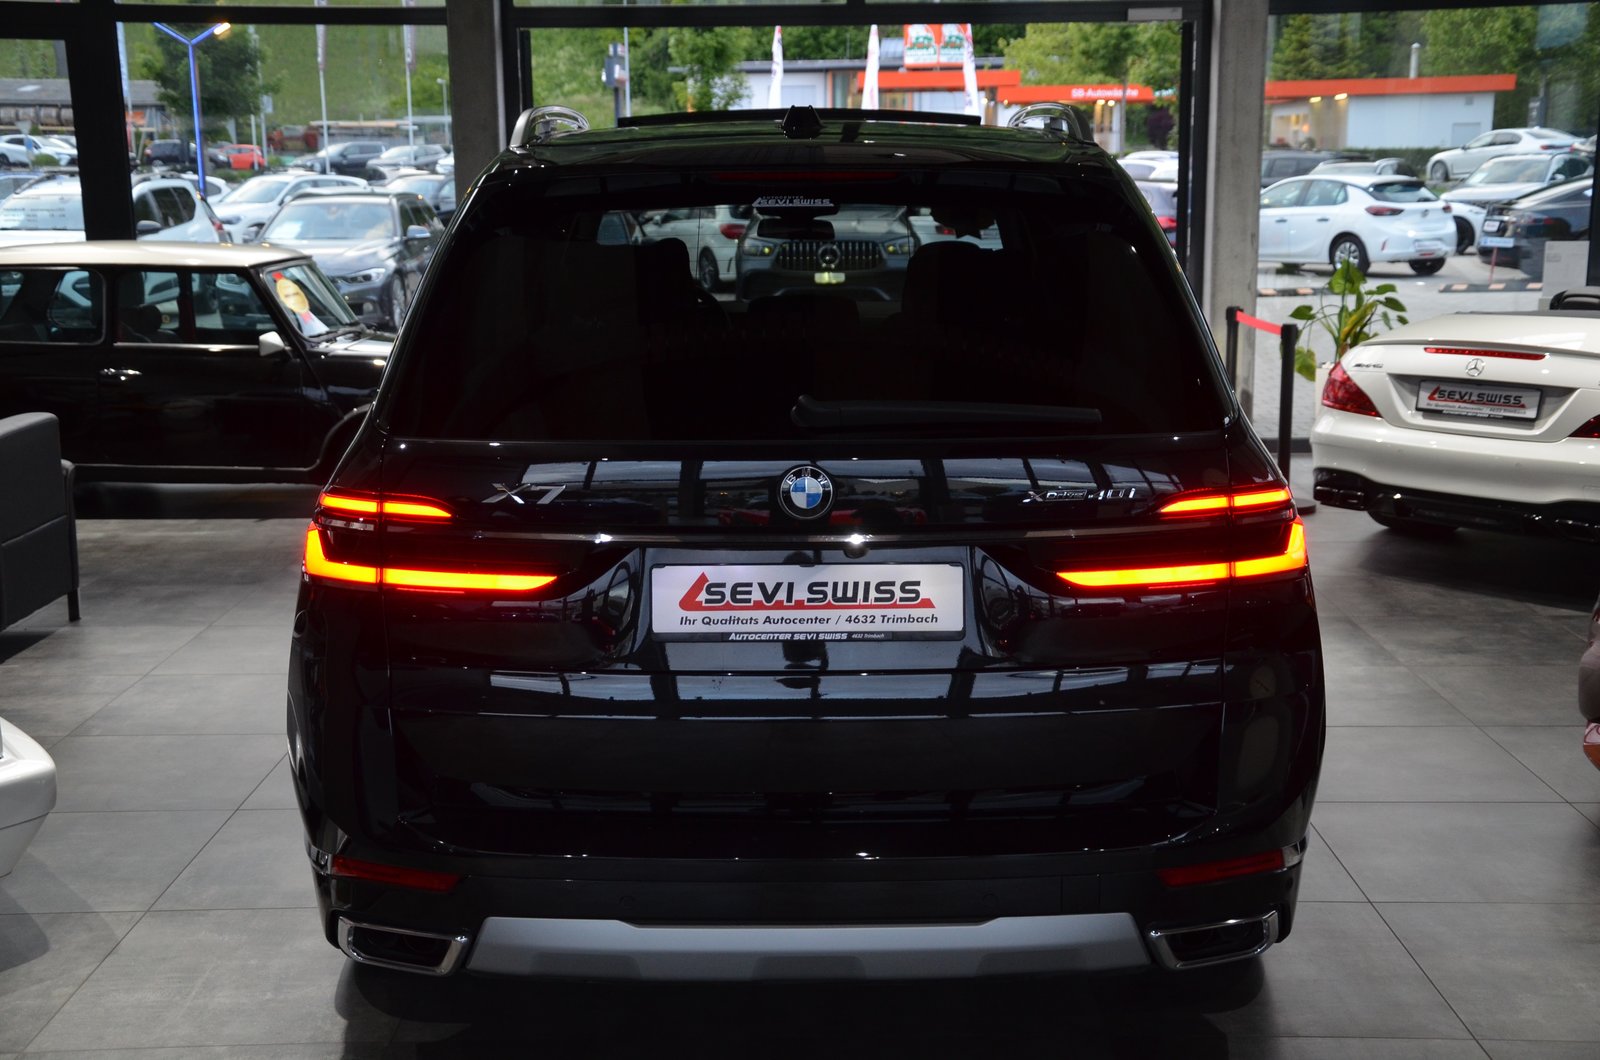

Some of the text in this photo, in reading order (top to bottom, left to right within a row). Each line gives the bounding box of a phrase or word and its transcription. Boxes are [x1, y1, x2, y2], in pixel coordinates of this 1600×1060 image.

[1437, 389, 1523, 405] SEVI SWISS
[785, 467, 828, 485] BMW
[482, 482, 567, 505] X7
[704, 580, 921, 605] SEVI SWISS
[680, 616, 697, 626] Ihr
[762, 615, 831, 625] Autocenter
[845, 614, 876, 624] 4632
[880, 613, 938, 624] Trimbach
[793, 632, 817, 641] SEVI
[818, 632, 849, 640] SWISS
